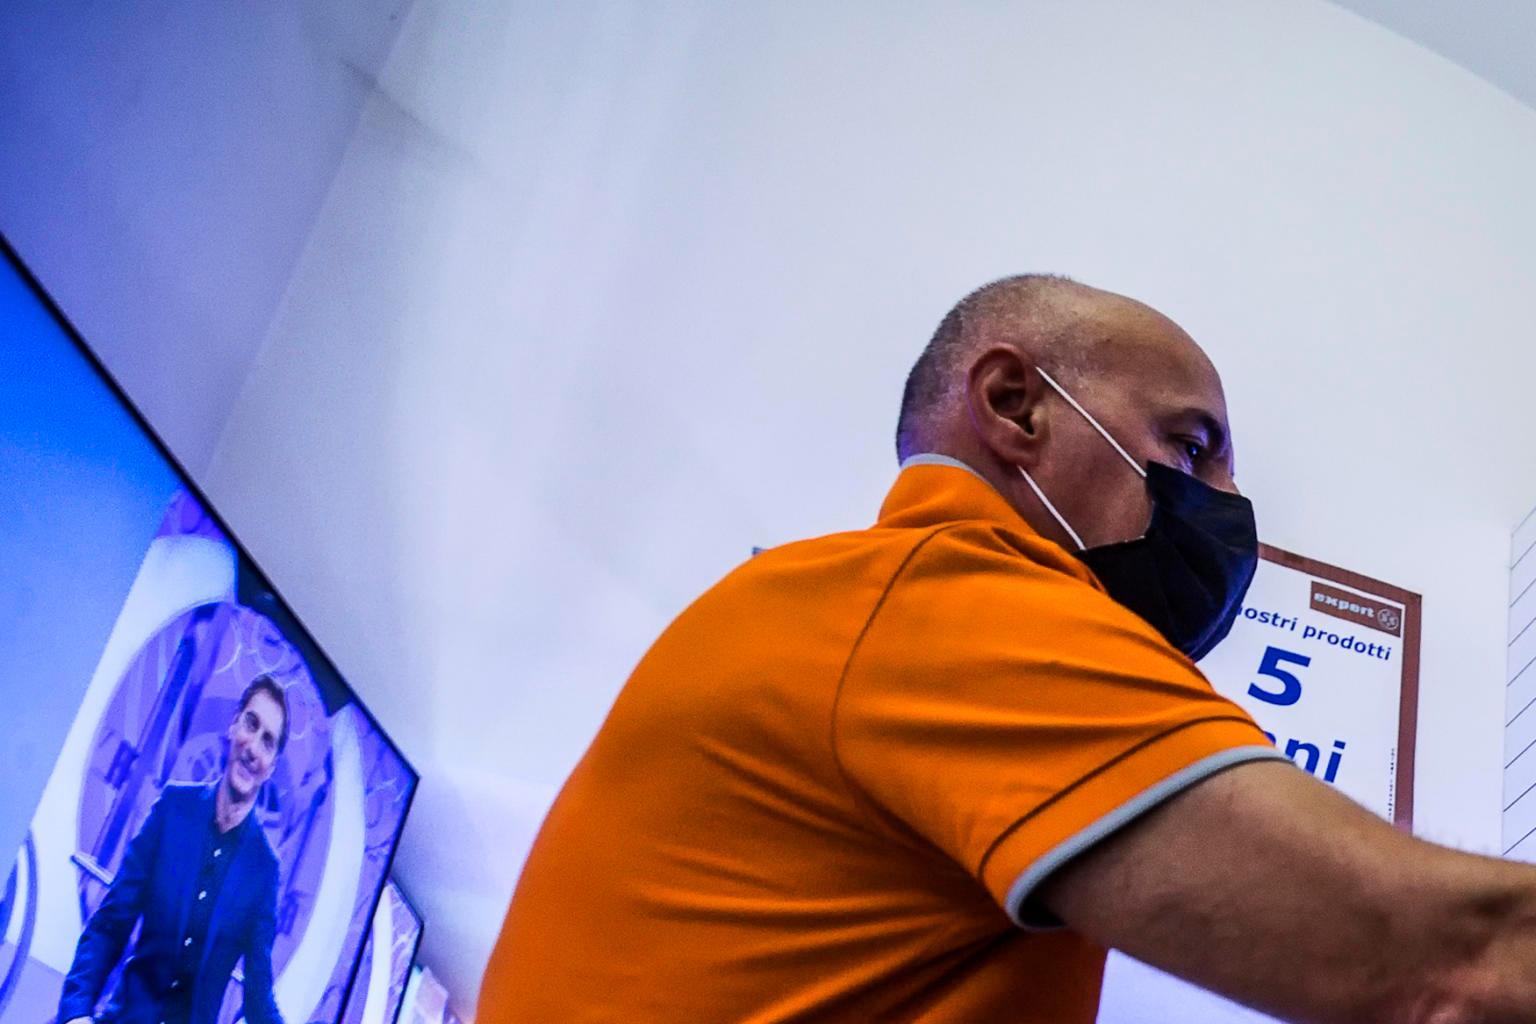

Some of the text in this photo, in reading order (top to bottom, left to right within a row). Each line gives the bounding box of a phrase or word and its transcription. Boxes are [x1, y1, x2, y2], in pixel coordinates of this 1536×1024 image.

[1313, 592, 1375, 618] expert
[1302, 624, 1392, 661] prodotti
[1247, 645, 1312, 707] 5
[1263, 730, 1347, 784] ni
